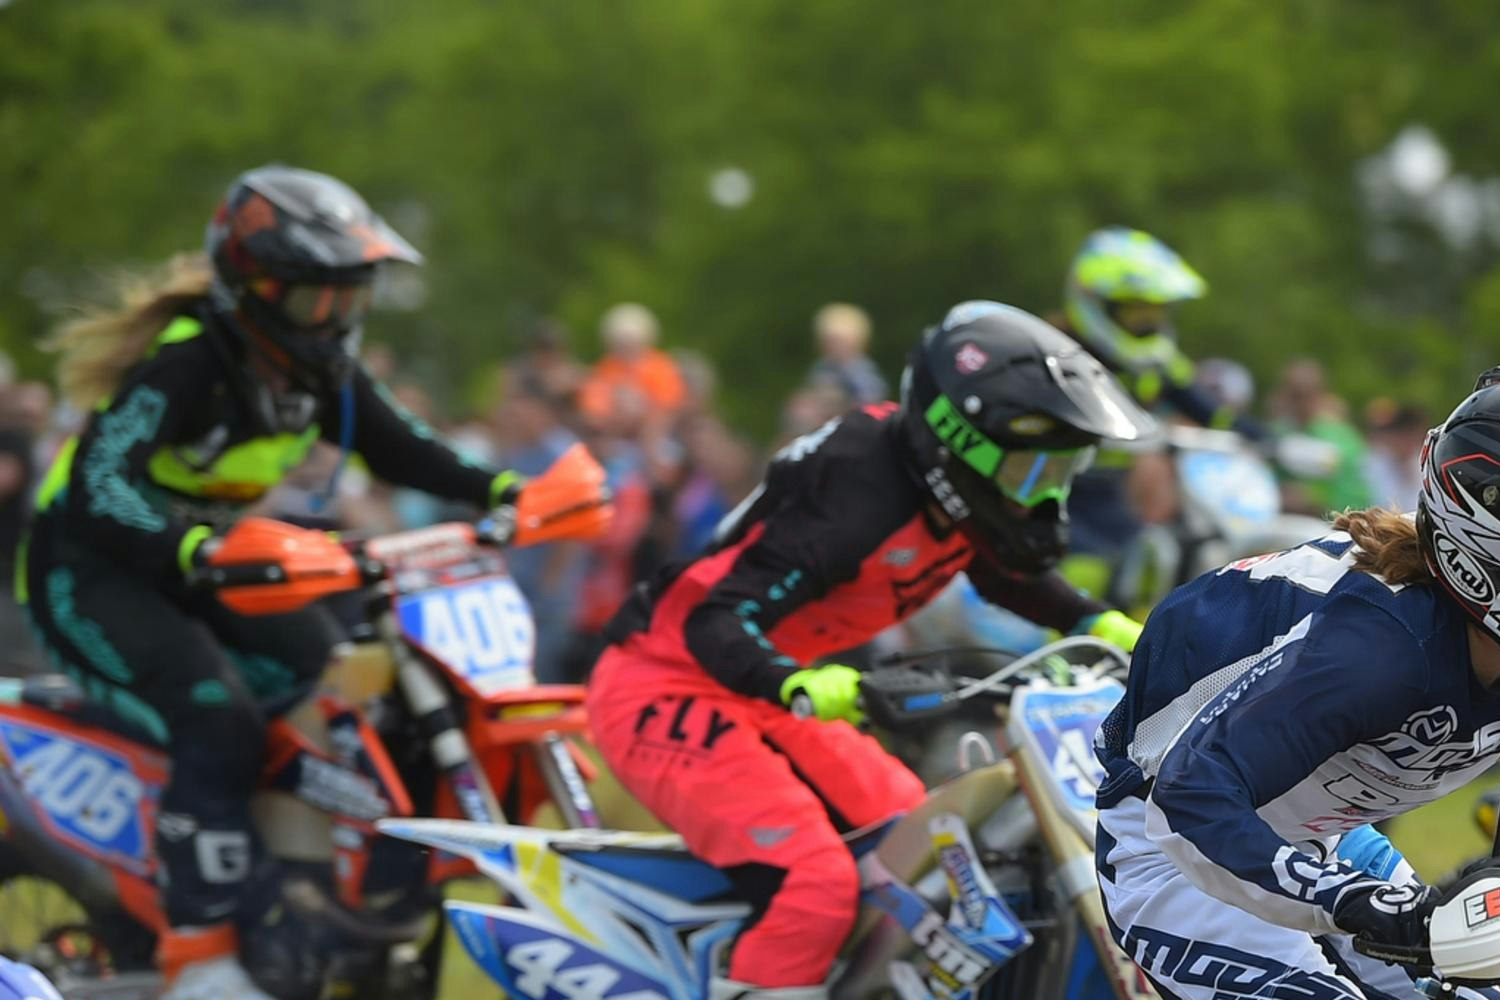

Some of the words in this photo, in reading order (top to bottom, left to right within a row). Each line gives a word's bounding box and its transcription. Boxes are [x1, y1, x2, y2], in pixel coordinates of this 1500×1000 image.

[1437, 546, 1487, 594] Arai
[634, 695, 736, 750] FLY
[16, 738, 143, 840] 406
